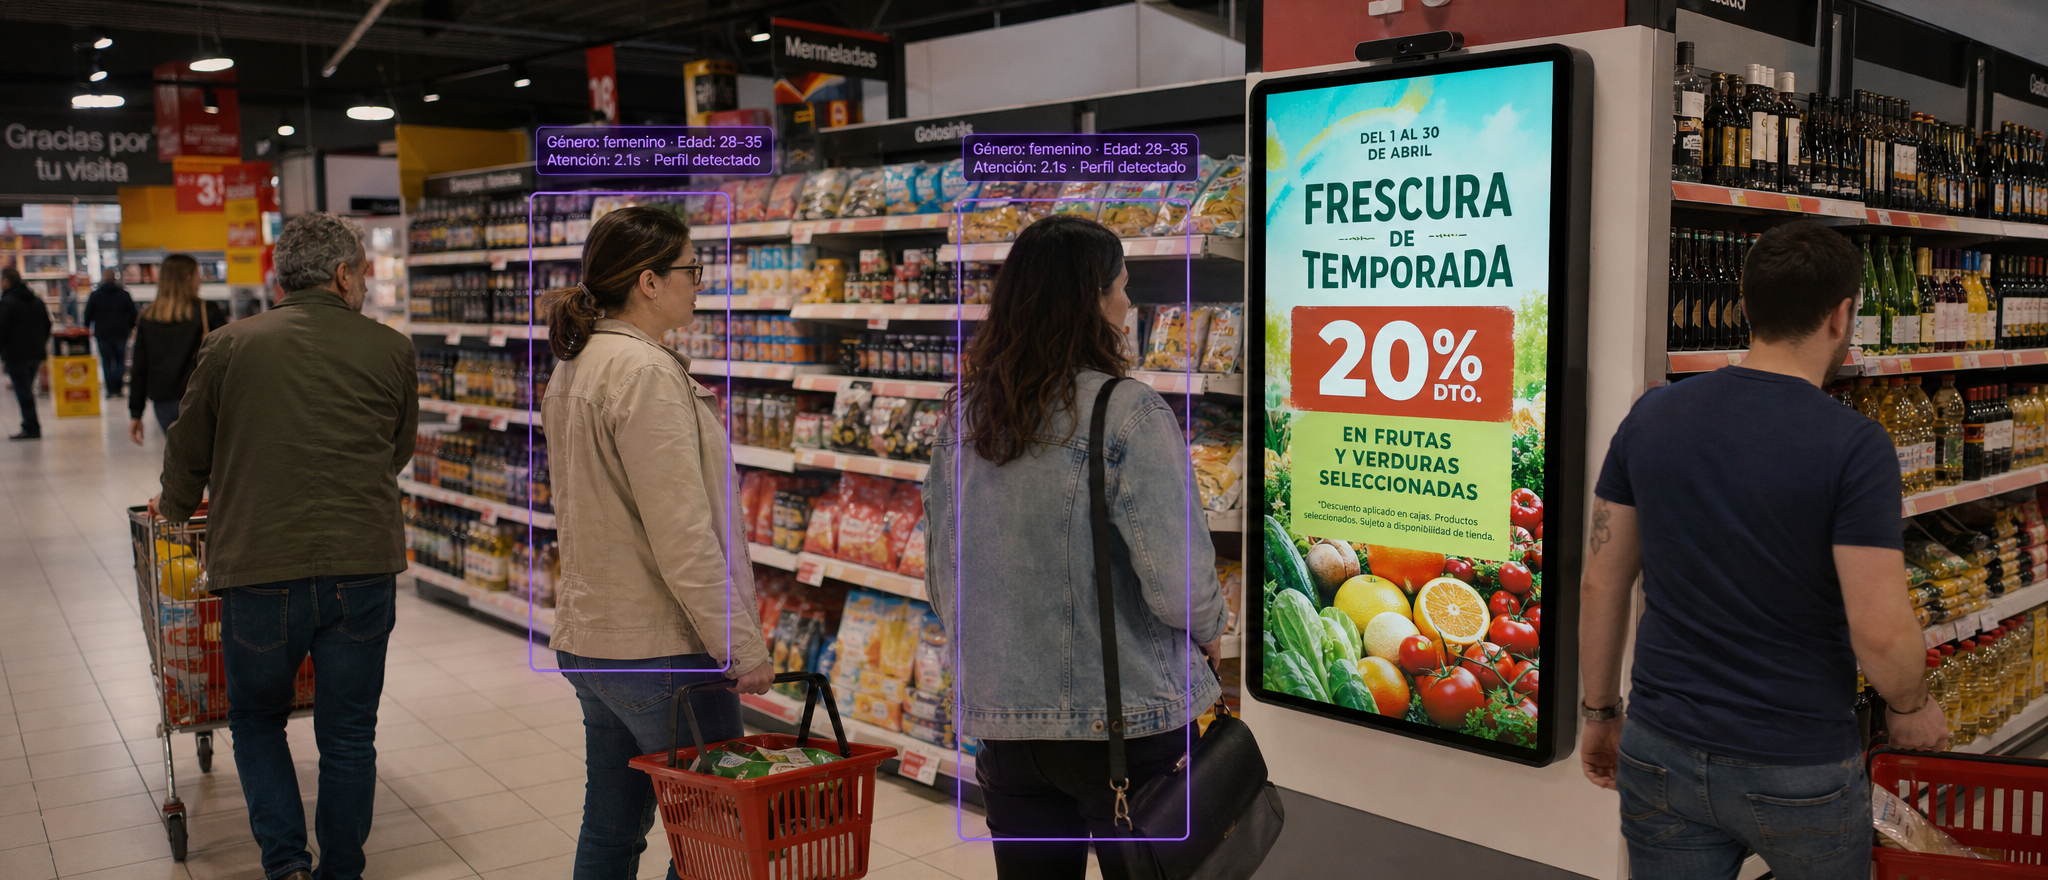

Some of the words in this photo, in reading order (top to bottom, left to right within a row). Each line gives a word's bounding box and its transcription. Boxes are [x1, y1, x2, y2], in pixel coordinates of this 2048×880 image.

[785, 34, 878, 69] Mermeladas
[5, 123, 104, 151] Gracias
[109, 133, 150, 156] por
[1360, 131, 1386, 144] DEL
[1390, 130, 1396, 142] 1
[1400, 128, 1418, 141] AL
[1422, 126, 1440, 140] 30
[1368, 149, 1386, 161] DE
[1390, 144, 1432, 159] ABRIL
[36, 157, 63, 180] tu
[66, 157, 129, 183] visita
[1304, 171, 1513, 225] FRESCURA
[1389, 230, 1415, 248] DE
[1302, 244, 1514, 289] TEMPORADA
[1318, 319, 1483, 401] 20%
[1433, 384, 1482, 403] DTO.
[1343, 426, 1367, 443] EN
[1375, 428, 1452, 450] FRUTAS
[1335, 448, 1346, 464] Y
[1352, 449, 1460, 475] VERDURAS
[1319, 469, 1478, 501] SELECCIONADAS
[1303, 510, 1358, 525] seleccionados.
[1360, 517, 1385, 530] Sujeto
[1393, 521, 1451, 536] disponibilidad
[1452, 528, 1464, 538] de
[1465, 529, 1495, 542] tienda.
[1362, 505, 1396, 518] aplicado
[1397, 509, 1408, 518] en
[1409, 511, 1432, 522] cajas.
[1434, 513, 1478, 526] Productos
